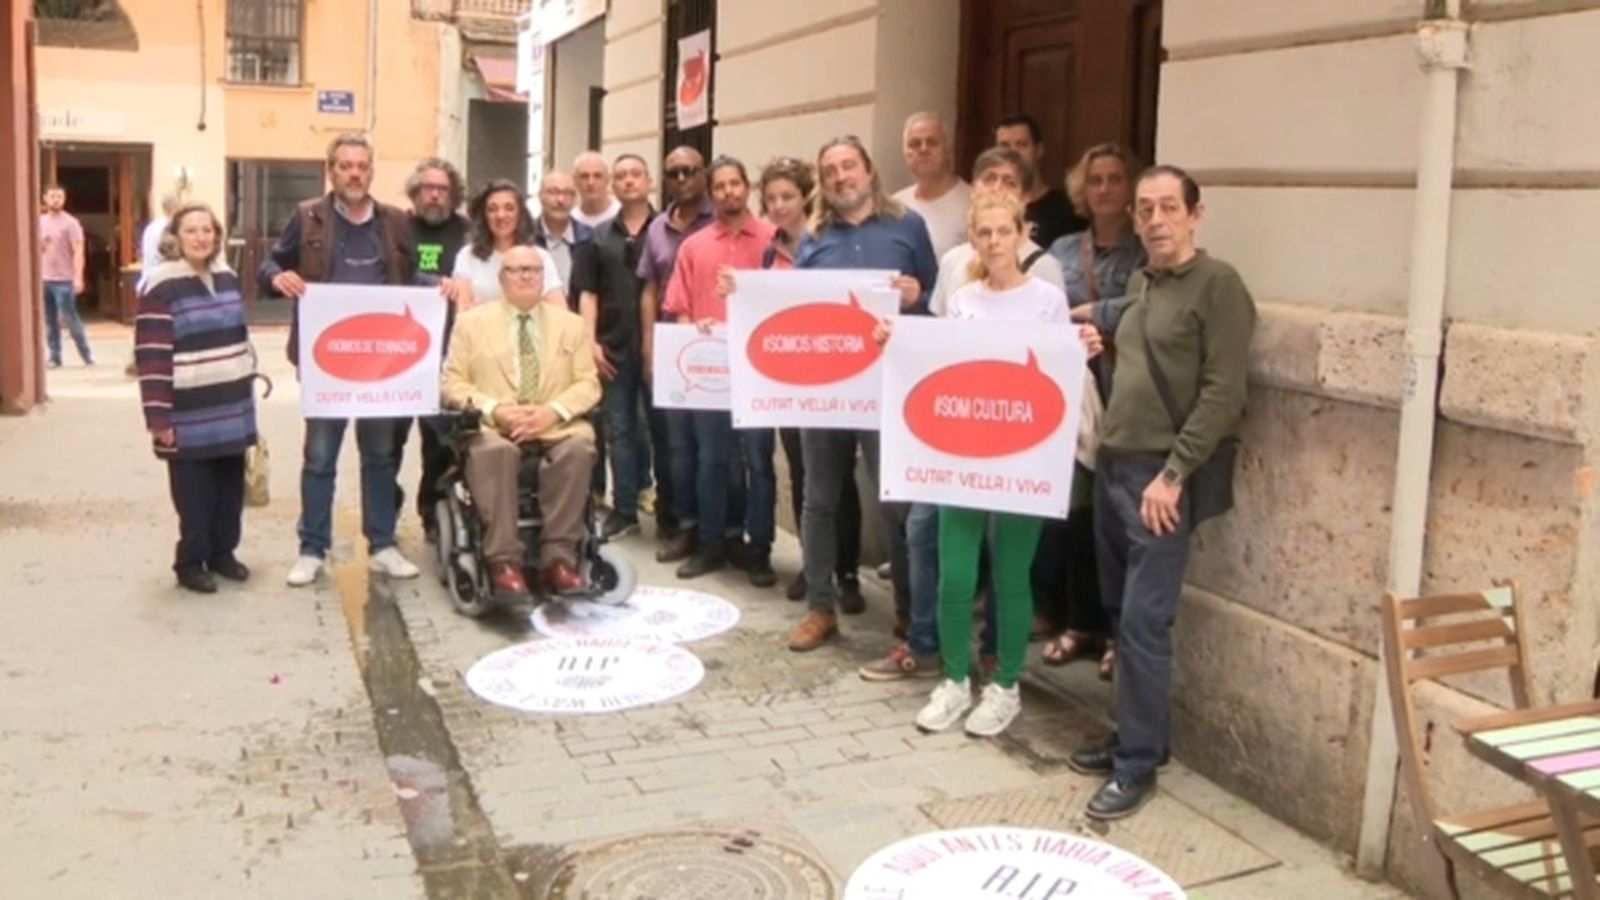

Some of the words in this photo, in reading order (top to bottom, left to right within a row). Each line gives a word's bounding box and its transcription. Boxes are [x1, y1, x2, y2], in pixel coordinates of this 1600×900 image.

[762, 334, 810, 353] #SOMOS
[811, 334, 865, 353] HISTORIA
[316, 391, 352, 404] CIUTAT
[357, 390, 390, 403] VELLA
[397, 389, 422, 402] VIVA
[752, 397, 793, 412] CIUTAT
[799, 397, 840, 412] VELLA
[850, 399, 879, 412] VIVA
[934, 394, 971, 419] #SOM
[973, 397, 1034, 423] CULTURA
[906, 467, 954, 484] CIUTAT
[959, 471, 1005, 491] VELLA
[1016, 479, 1052, 495] VIVA
[939, 834, 1024, 854] ANTES
